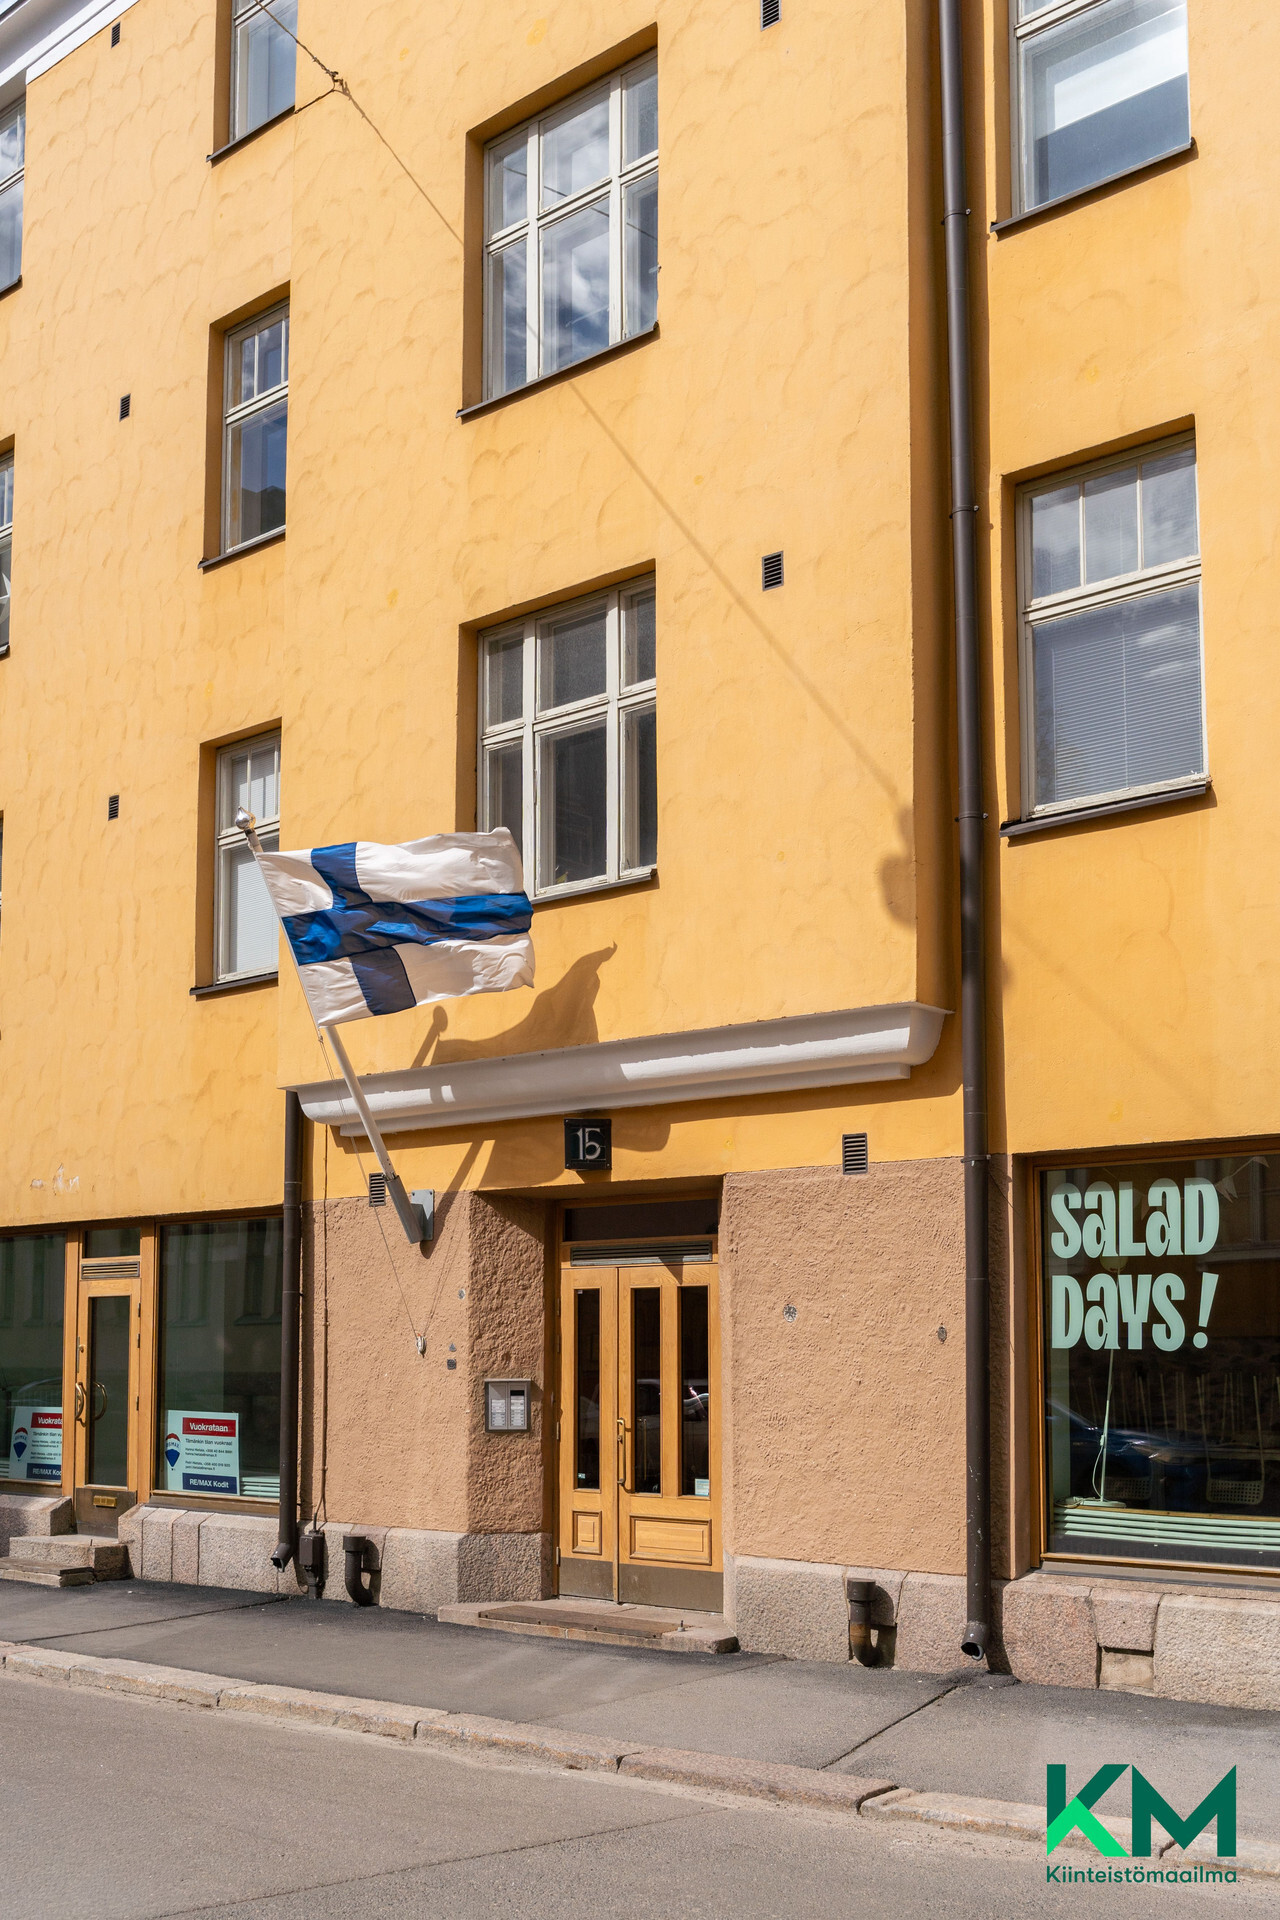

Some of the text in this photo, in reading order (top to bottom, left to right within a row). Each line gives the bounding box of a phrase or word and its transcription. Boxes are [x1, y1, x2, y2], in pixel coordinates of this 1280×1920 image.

[575, 1127, 602, 1160] 15
[189, 1423, 228, 1432] Vuokrataan
[189, 1479, 229, 1488] RE/MAX Kodit
